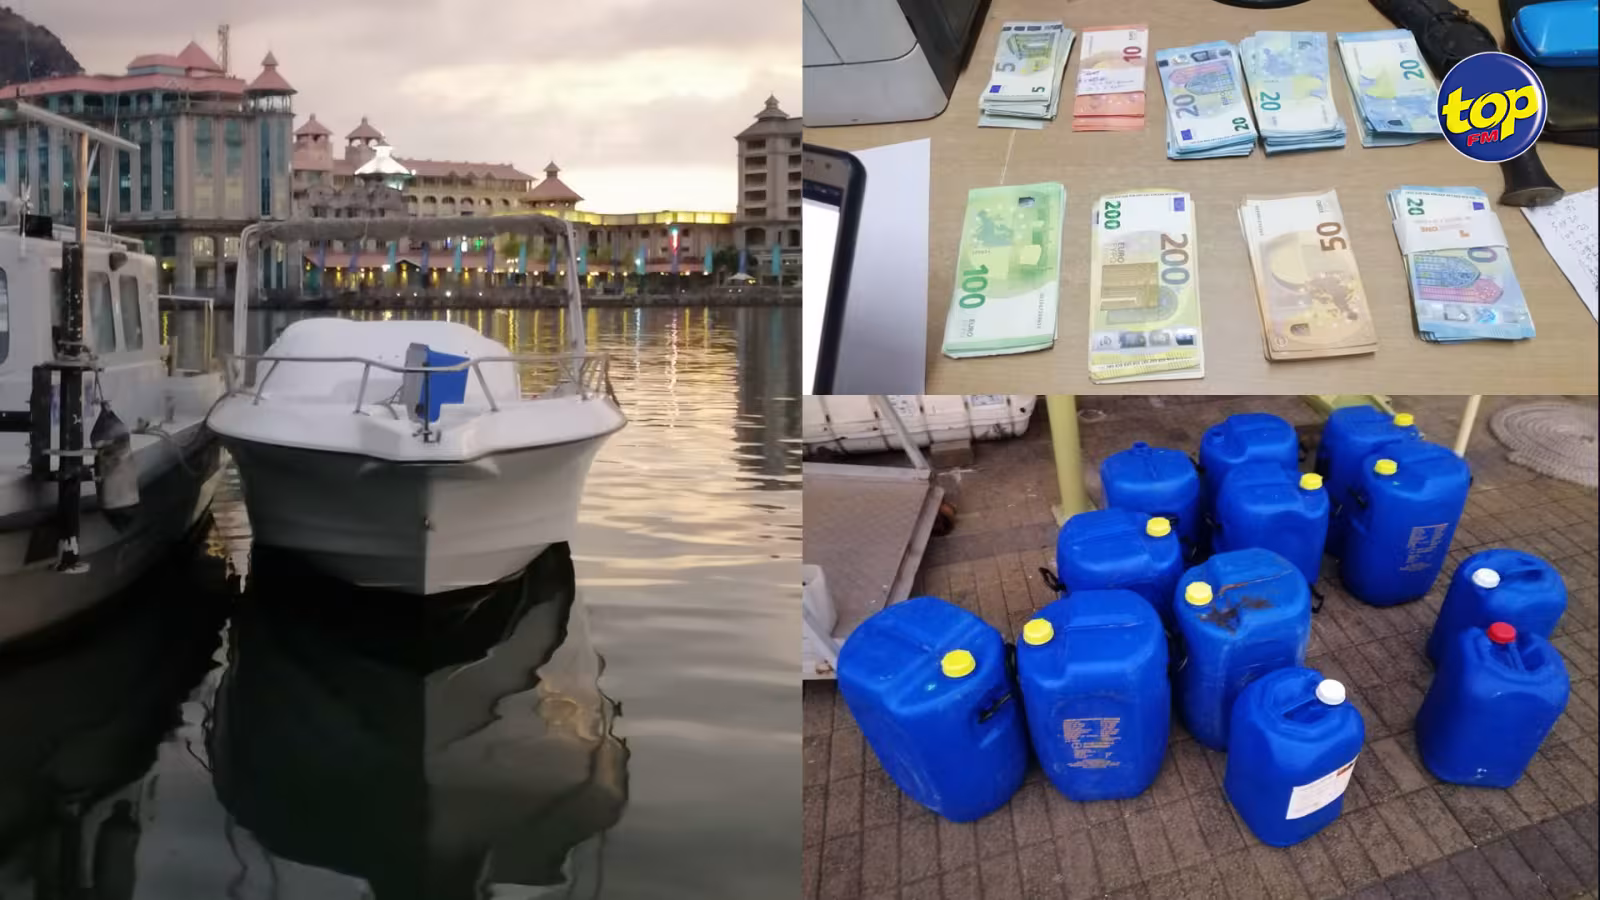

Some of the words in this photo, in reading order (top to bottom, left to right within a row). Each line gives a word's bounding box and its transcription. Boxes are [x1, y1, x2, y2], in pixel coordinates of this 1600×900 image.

[1123, 46, 1142, 63] 10
[995, 62, 1016, 73] 5
[1399, 59, 1424, 80] 20
[1173, 94, 1199, 119] 20
[1260, 91, 1281, 111] 20
[1232, 116, 1250, 132] 20
[1104, 200, 1121, 230] 200
[1406, 197, 1425, 216] 20
[1316, 221, 1347, 251] 50
[1160, 232, 1190, 285] 200
[959, 264, 989, 309] 100
